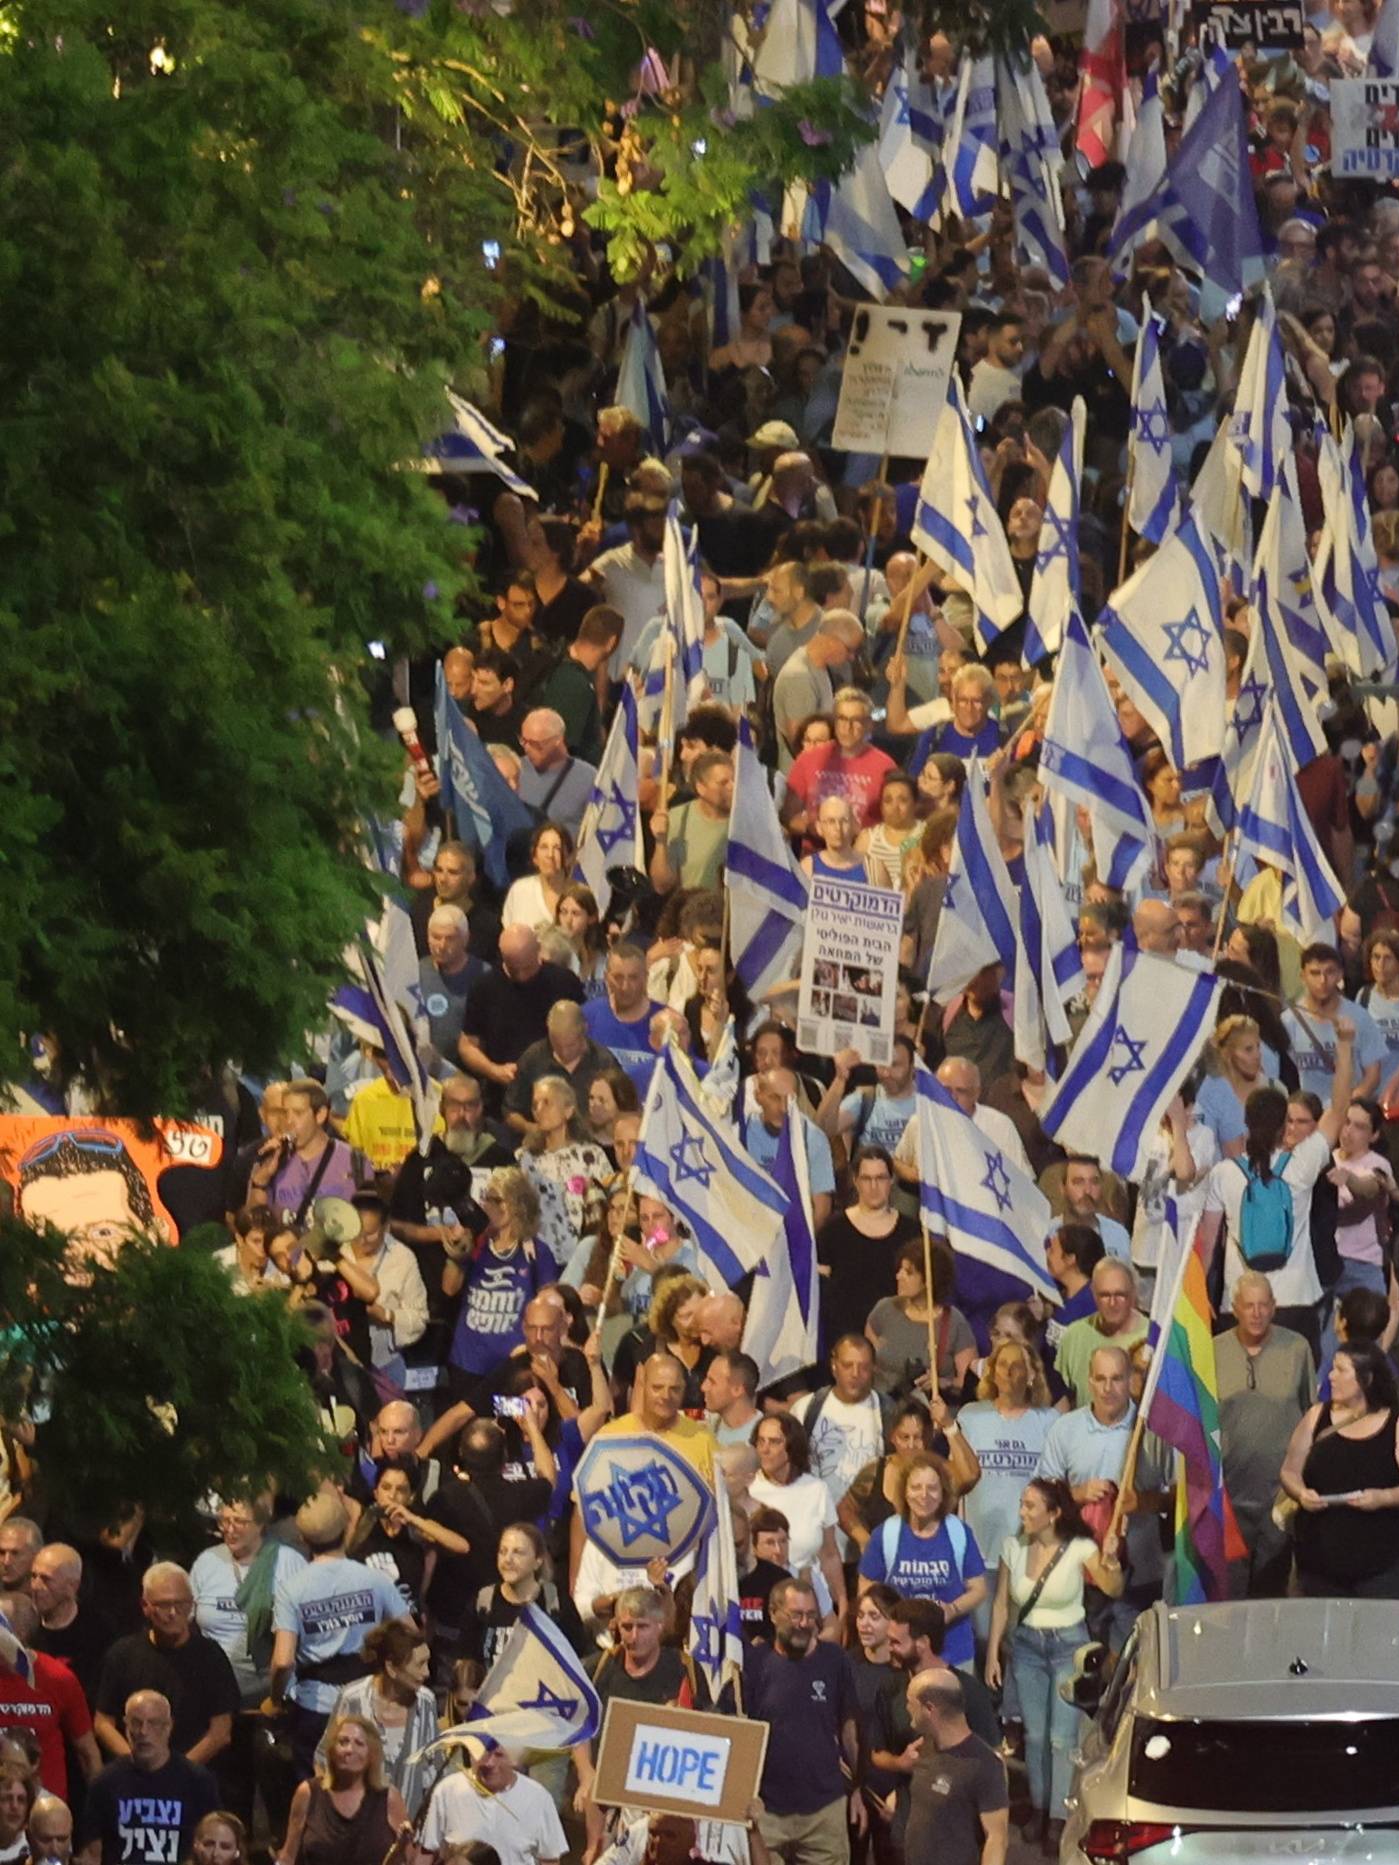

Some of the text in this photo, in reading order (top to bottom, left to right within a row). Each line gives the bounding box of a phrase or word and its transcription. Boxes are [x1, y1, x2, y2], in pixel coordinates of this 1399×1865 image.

[1255, 8, 1302, 42] רבין
[812, 884, 901, 916] הדמוקרטים
[854, 915, 899, 937] בראשות
[818, 944, 884, 967] של המחאה
[863, 935, 893, 953] הבית
[636, 1741, 720, 1791] HOPE
[118, 1799, 182, 1825] נצביע
[118, 1824, 180, 1863] נציל
